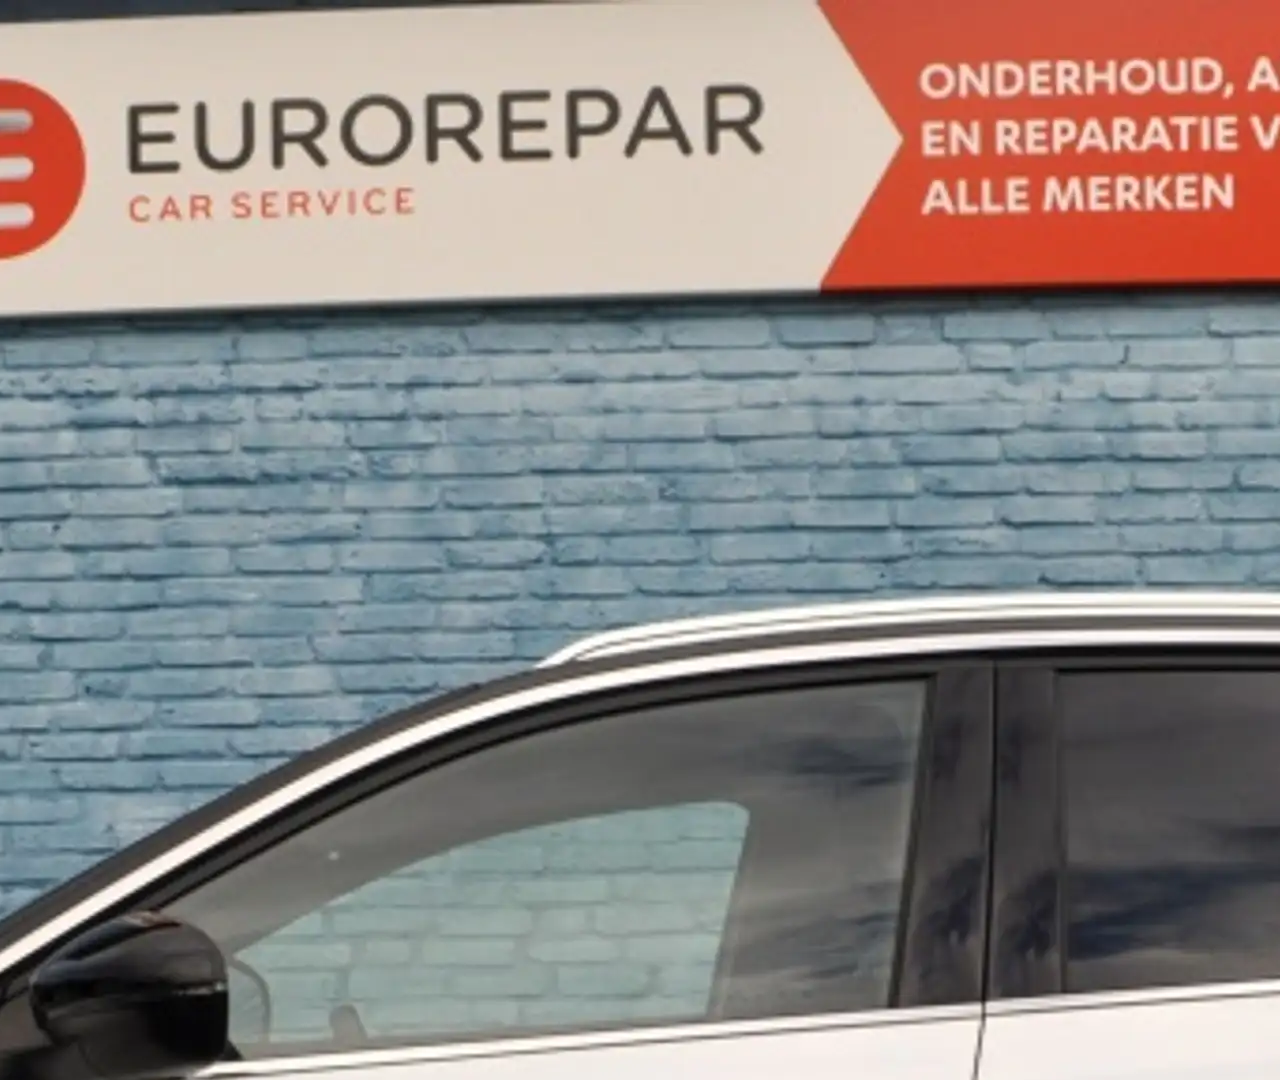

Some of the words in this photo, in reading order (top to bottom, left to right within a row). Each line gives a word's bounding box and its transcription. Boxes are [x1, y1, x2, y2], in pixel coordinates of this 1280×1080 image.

[919, 57, 1234, 99] ONDERHOUD,
[127, 84, 764, 174] EUROREPAR
[921, 120, 981, 157] EN
[995, 115, 1239, 155] REPARATIE
[128, 193, 214, 225] CAR
[230, 186, 415, 220] SERVICE
[921, 177, 1030, 215] ALLE
[1042, 173, 1234, 212] MERKEN
